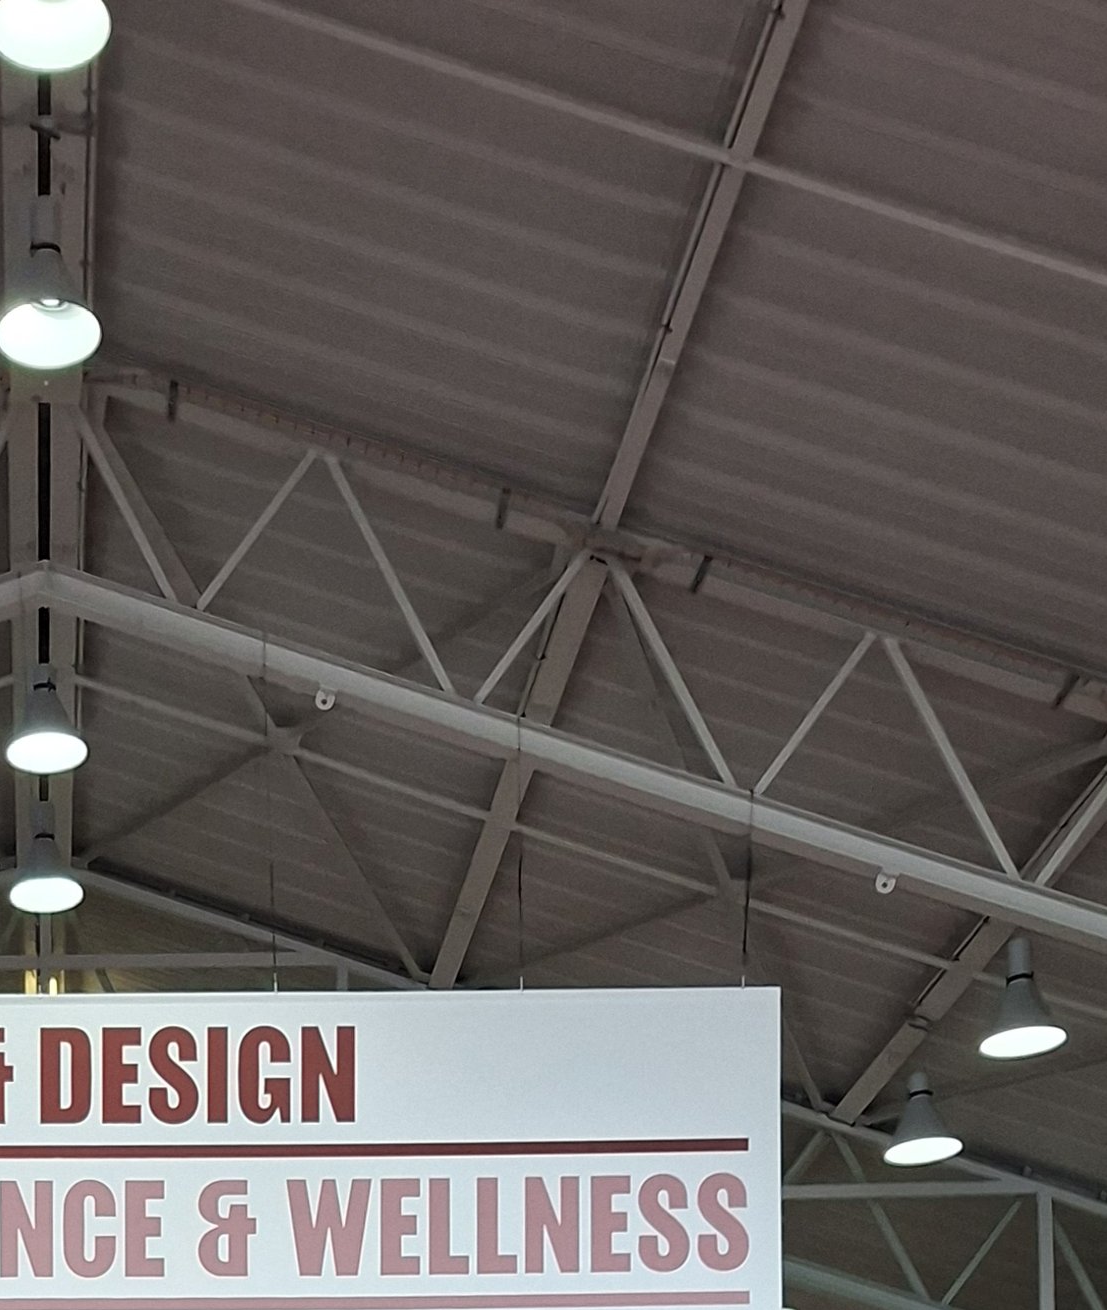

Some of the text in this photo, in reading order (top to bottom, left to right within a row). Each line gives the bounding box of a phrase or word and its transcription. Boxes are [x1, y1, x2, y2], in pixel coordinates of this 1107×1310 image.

[39, 1026, 356, 1125] DESIGN
[197, 1179, 257, 1277] &
[286, 1172, 750, 1277] WELLNESS
